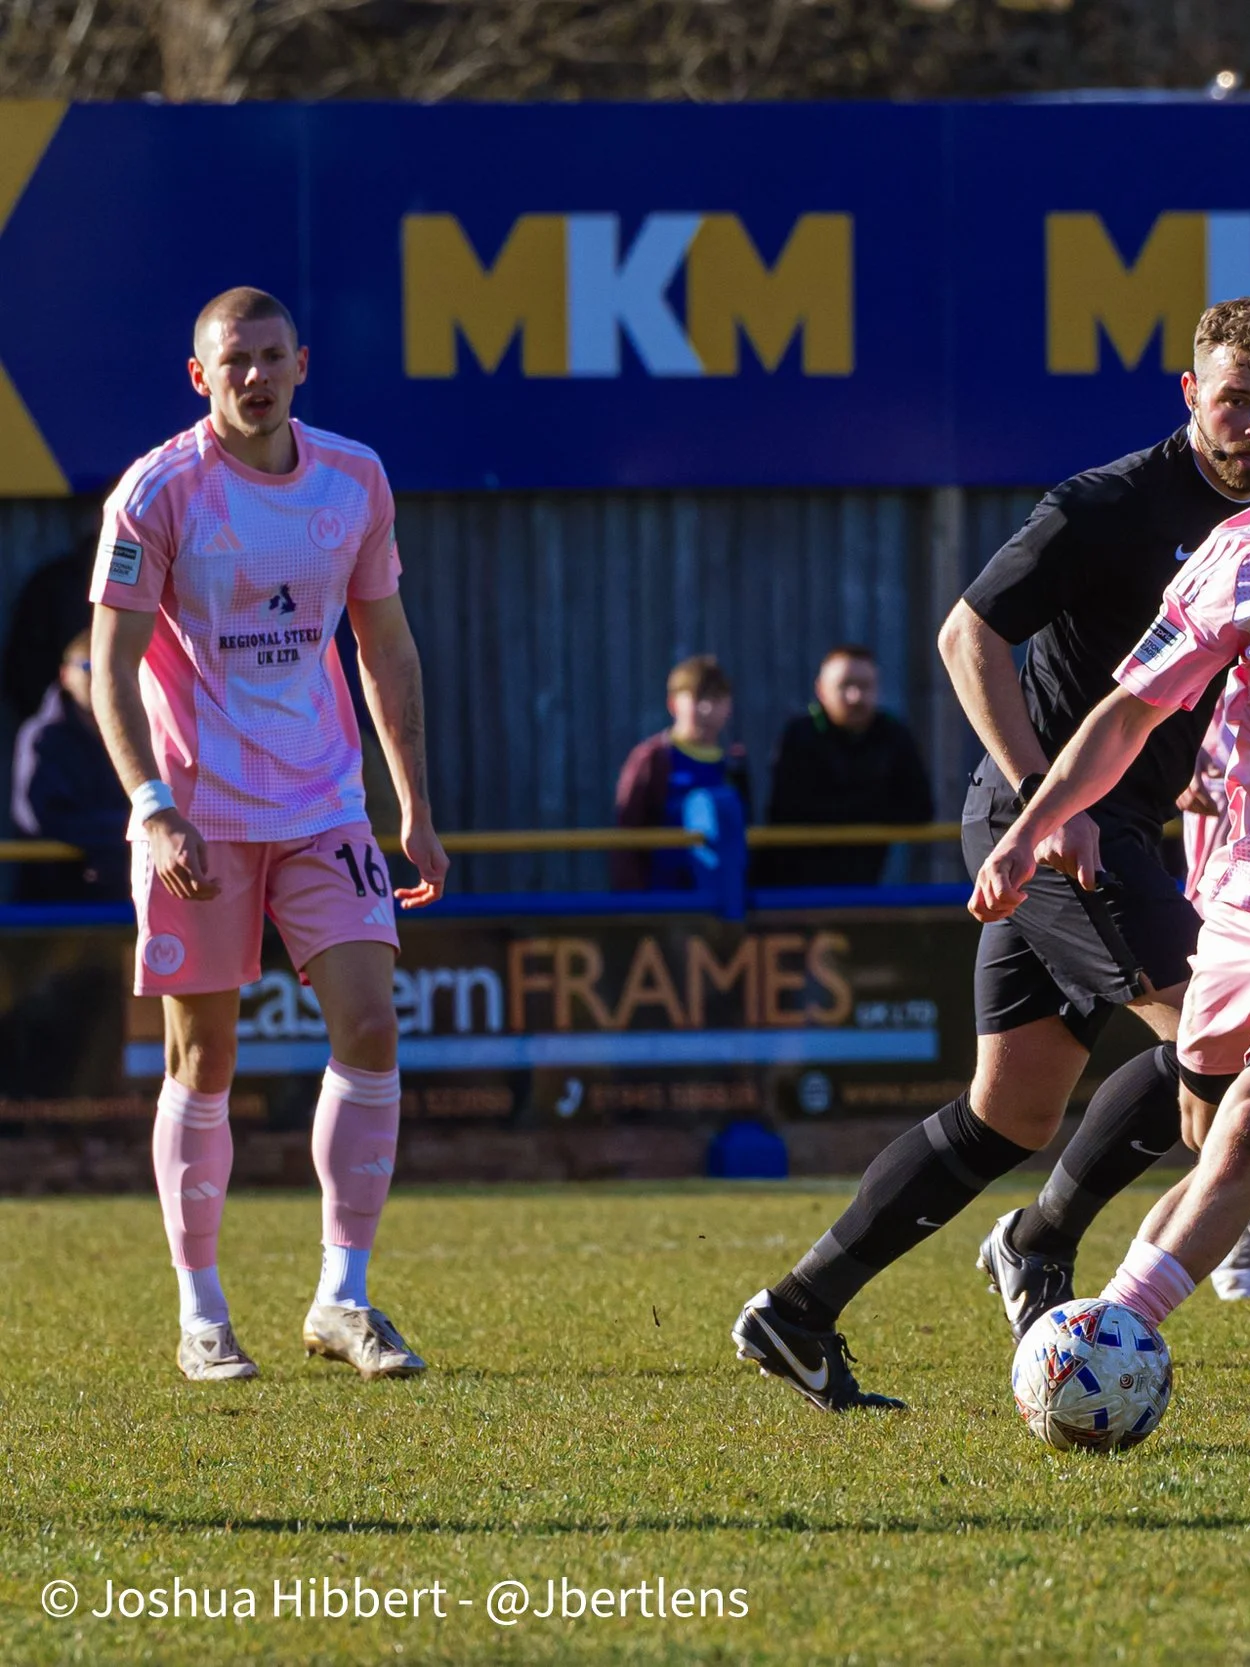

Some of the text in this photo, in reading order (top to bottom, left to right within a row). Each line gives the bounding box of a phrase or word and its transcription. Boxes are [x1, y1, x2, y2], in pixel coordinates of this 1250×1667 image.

[403, 213, 854, 378] MKM
[219, 627, 323, 650] REGIONAL STEEL
[257, 648, 300, 665] UK LTD
[334, 843, 388, 898] 16
[507, 934, 853, 1028] FRAMES
